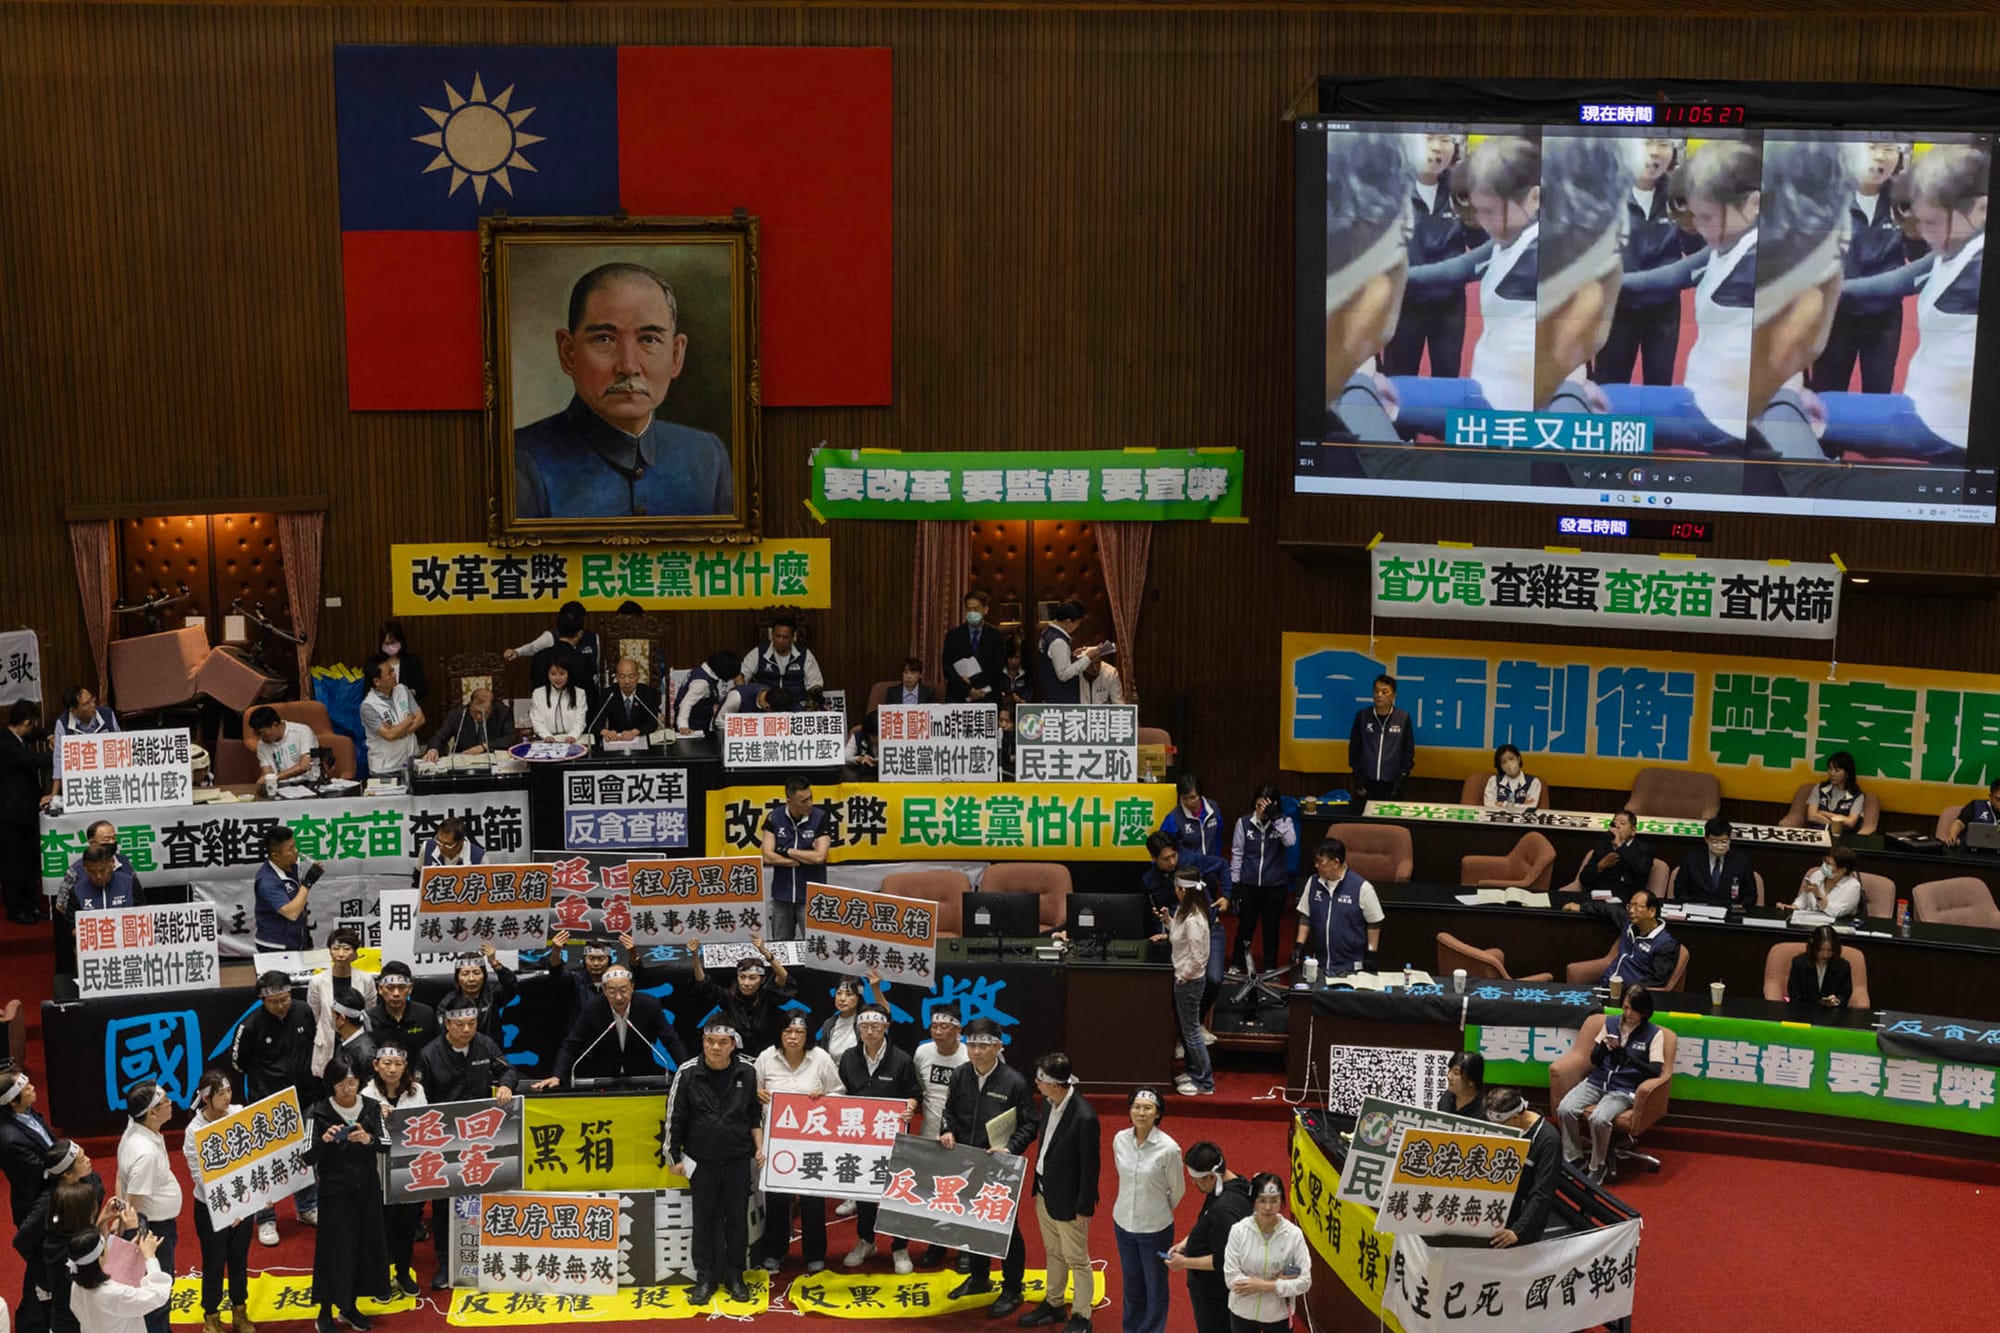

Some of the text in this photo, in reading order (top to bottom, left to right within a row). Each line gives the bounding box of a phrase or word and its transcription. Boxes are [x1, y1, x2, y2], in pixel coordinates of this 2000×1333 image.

[1582, 105, 1653, 122] 現在時間
[1455, 414, 1647, 454] 出手又出腳
[824, 466, 1229, 502] 要改革 要監督 要查弊
[1560, 517, 1705, 539] 發言時間 1:04
[580, 551, 809, 598] 民進黨怕什麼
[1378, 556, 1486, 606] 查光電
[1603, 568, 1715, 618] 查疫苗
[1293, 649, 1696, 762] 全面制衡
[727, 717, 759, 737] 調查
[880, 711, 904, 740] 調查
[1040, 708, 1133, 743] 當家鬧事
[63, 741, 98, 772] 調查
[727, 739, 841, 763] 民進黨怕什麼?
[882, 745, 994, 776] 民進黨怕什麼?
[1019, 748, 1132, 782] 民主之恥
[66, 771, 187, 807] 民進黨怕什麼?
[568, 773, 684, 805] 國會改革
[568, 811, 686, 844] 反貪查弊
[900, 796, 1154, 848] 民進黨怕什麼
[425, 871, 549, 904] 程序黑箱
[553, 856, 629, 893] 退回
[632, 864, 760, 898] 程序黑箱
[420, 914, 544, 939] 議事錄無效
[551, 894, 632, 933] 重審
[634, 907, 761, 933] 議事錄無效
[809, 892, 931, 940] 程序黑箱
[79, 916, 117, 951] 調查
[82, 950, 214, 991] 民進黨怕什麼?
[807, 935, 930, 974] 議事錄無效
[201, 1101, 299, 1171] 違法表決
[403, 1107, 506, 1148] 退回
[801, 1105, 902, 1140] 反黑箱
[528, 1119, 614, 1175] 黑箱
[1398, 1139, 1521, 1185] 違法表決
[404, 1144, 504, 1191] 重審
[883, 1167, 1015, 1224] 反黑箱
[1387, 1191, 1507, 1225] 議事錄無效
[484, 1204, 615, 1241] 程序黑箱
[482, 1251, 614, 1281] 議事錄無效
[801, 1283, 930, 1309] 反黑箱
